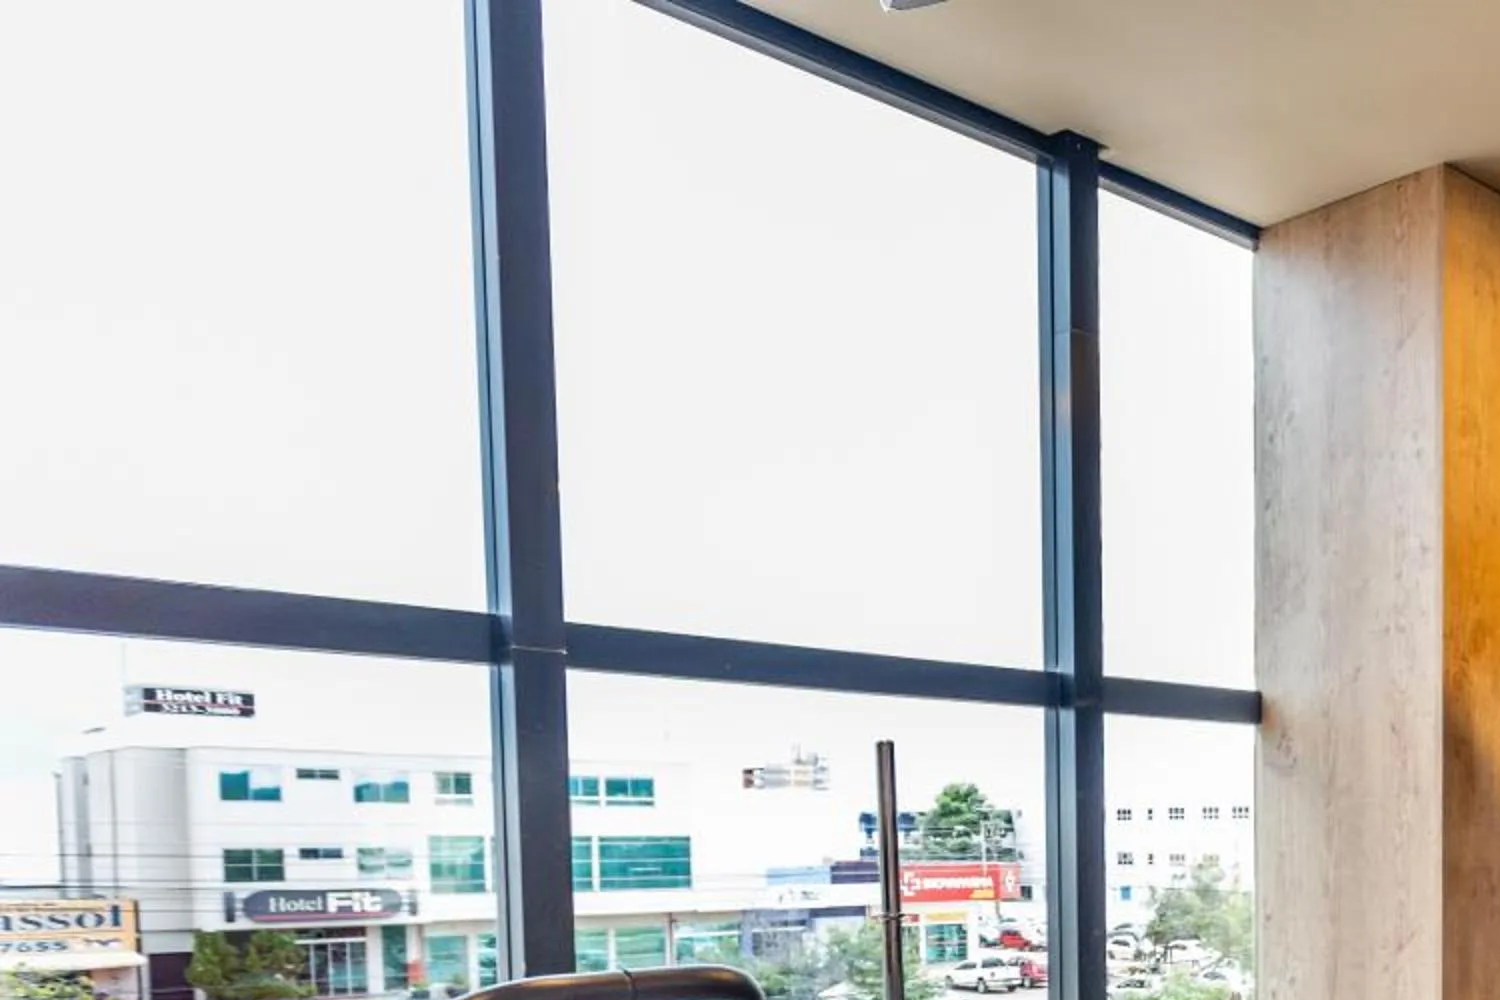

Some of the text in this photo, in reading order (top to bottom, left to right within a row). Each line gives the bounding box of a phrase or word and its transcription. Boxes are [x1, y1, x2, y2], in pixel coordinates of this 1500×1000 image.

[155, 689, 242, 706] Hotel Fit
[268, 891, 382, 914] Hotel Fit
